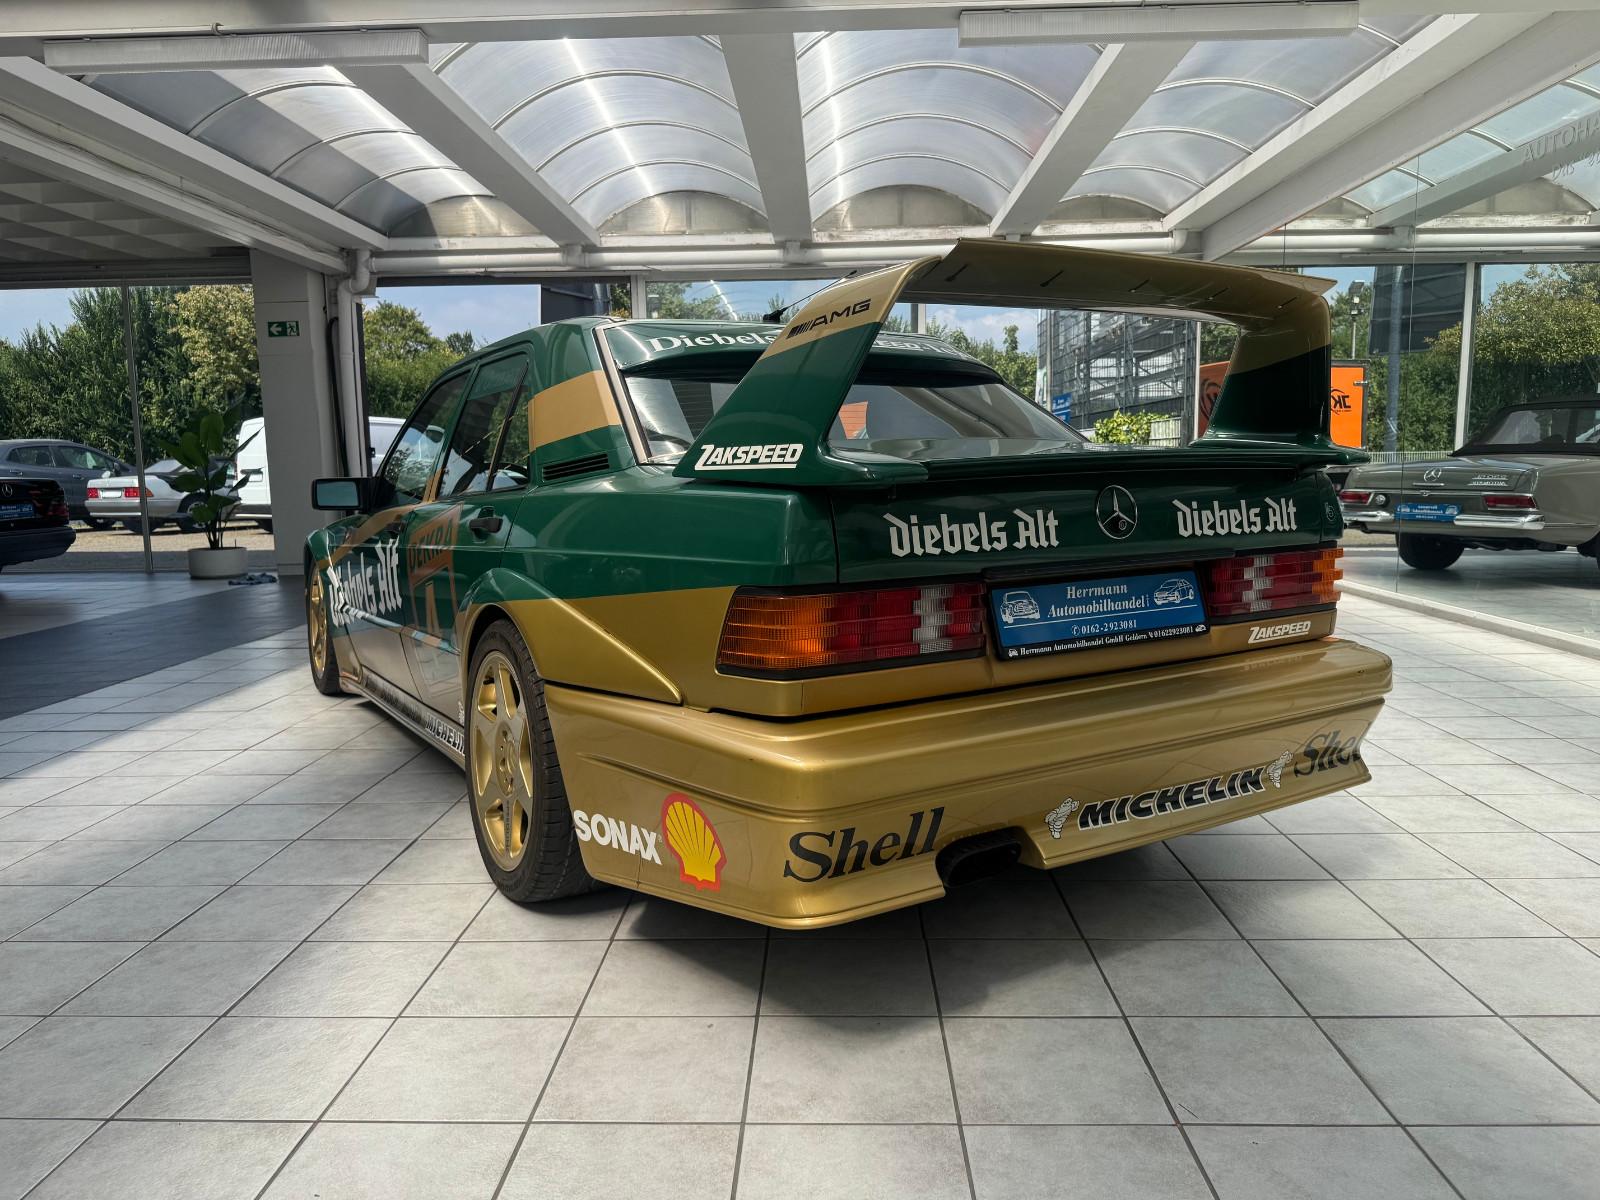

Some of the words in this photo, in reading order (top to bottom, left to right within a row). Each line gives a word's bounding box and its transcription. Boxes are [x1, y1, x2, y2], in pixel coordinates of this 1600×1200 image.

[809, 299, 871, 331] AMG
[694, 443, 804, 471] ZAKSPEED
[882, 510, 1008, 558] Diebels
[1012, 507, 1060, 550] Alt
[1172, 498, 1262, 538] Diebels
[1264, 496, 1298, 533] Alt
[1047, 595, 1145, 618] Automobilhandel
[1066, 584, 1128, 599] Herrmann
[1020, 645, 1052, 656] Herrmann
[1053, 637, 1104, 651] Automobilhandel
[1248, 621, 1312, 644] ZAKSPEED
[1294, 730, 1361, 777] Shel
[1078, 765, 1266, 831] MICHELIN
[573, 810, 662, 865] SONAX
[783, 806, 945, 882] Shell
